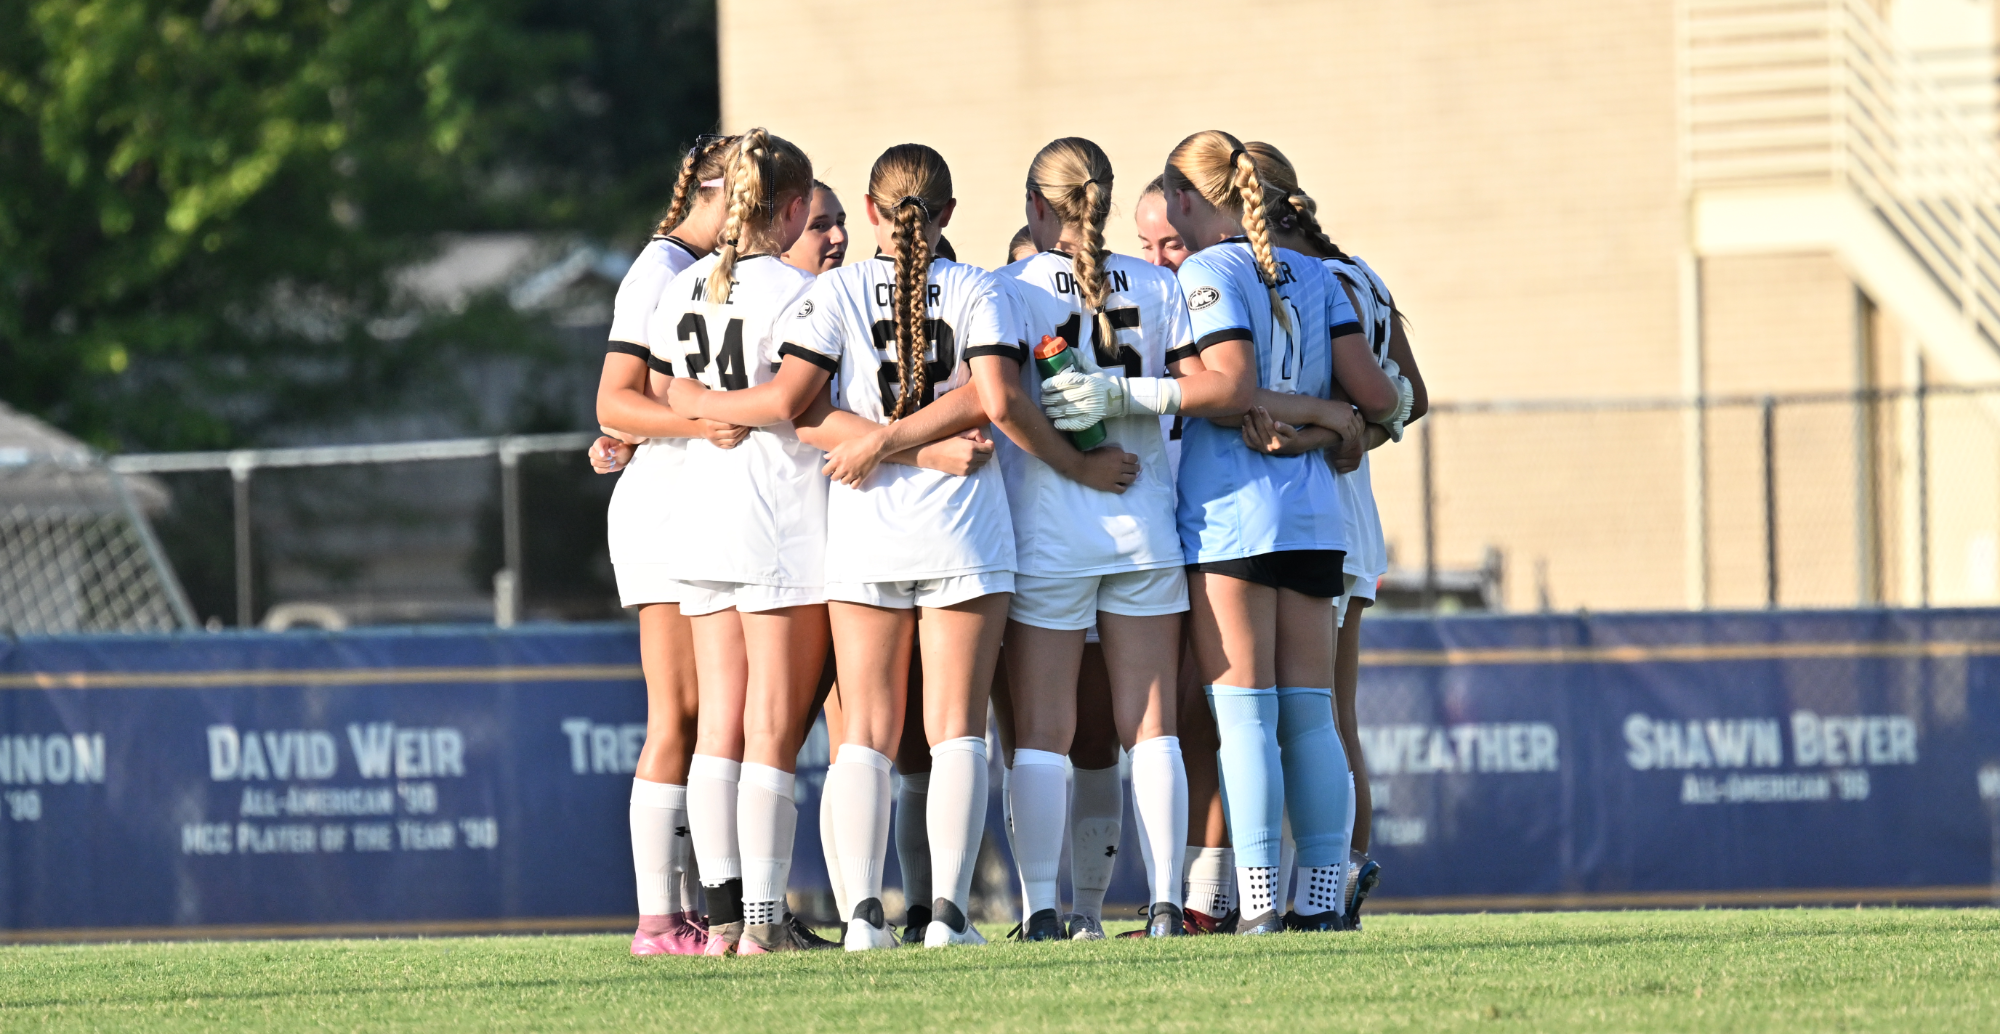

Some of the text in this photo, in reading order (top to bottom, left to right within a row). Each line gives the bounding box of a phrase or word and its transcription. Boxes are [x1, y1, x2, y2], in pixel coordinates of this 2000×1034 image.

[875, 283, 941, 307] COR
[676, 312, 749, 391] 24
[206, 722, 466, 781] DAVID WEIR
[561, 717, 648, 775] TRE
[1358, 722, 1560, 775] WEATHER
[1623, 709, 1918, 770] SHAWN BEYER
[240, 785, 393, 818] ALL-AMERICAN
[236, 819, 317, 854] PLAYER
[319, 821, 347, 852] OF
[351, 821, 393, 852] THE
[396, 818, 455, 851] YEAR
